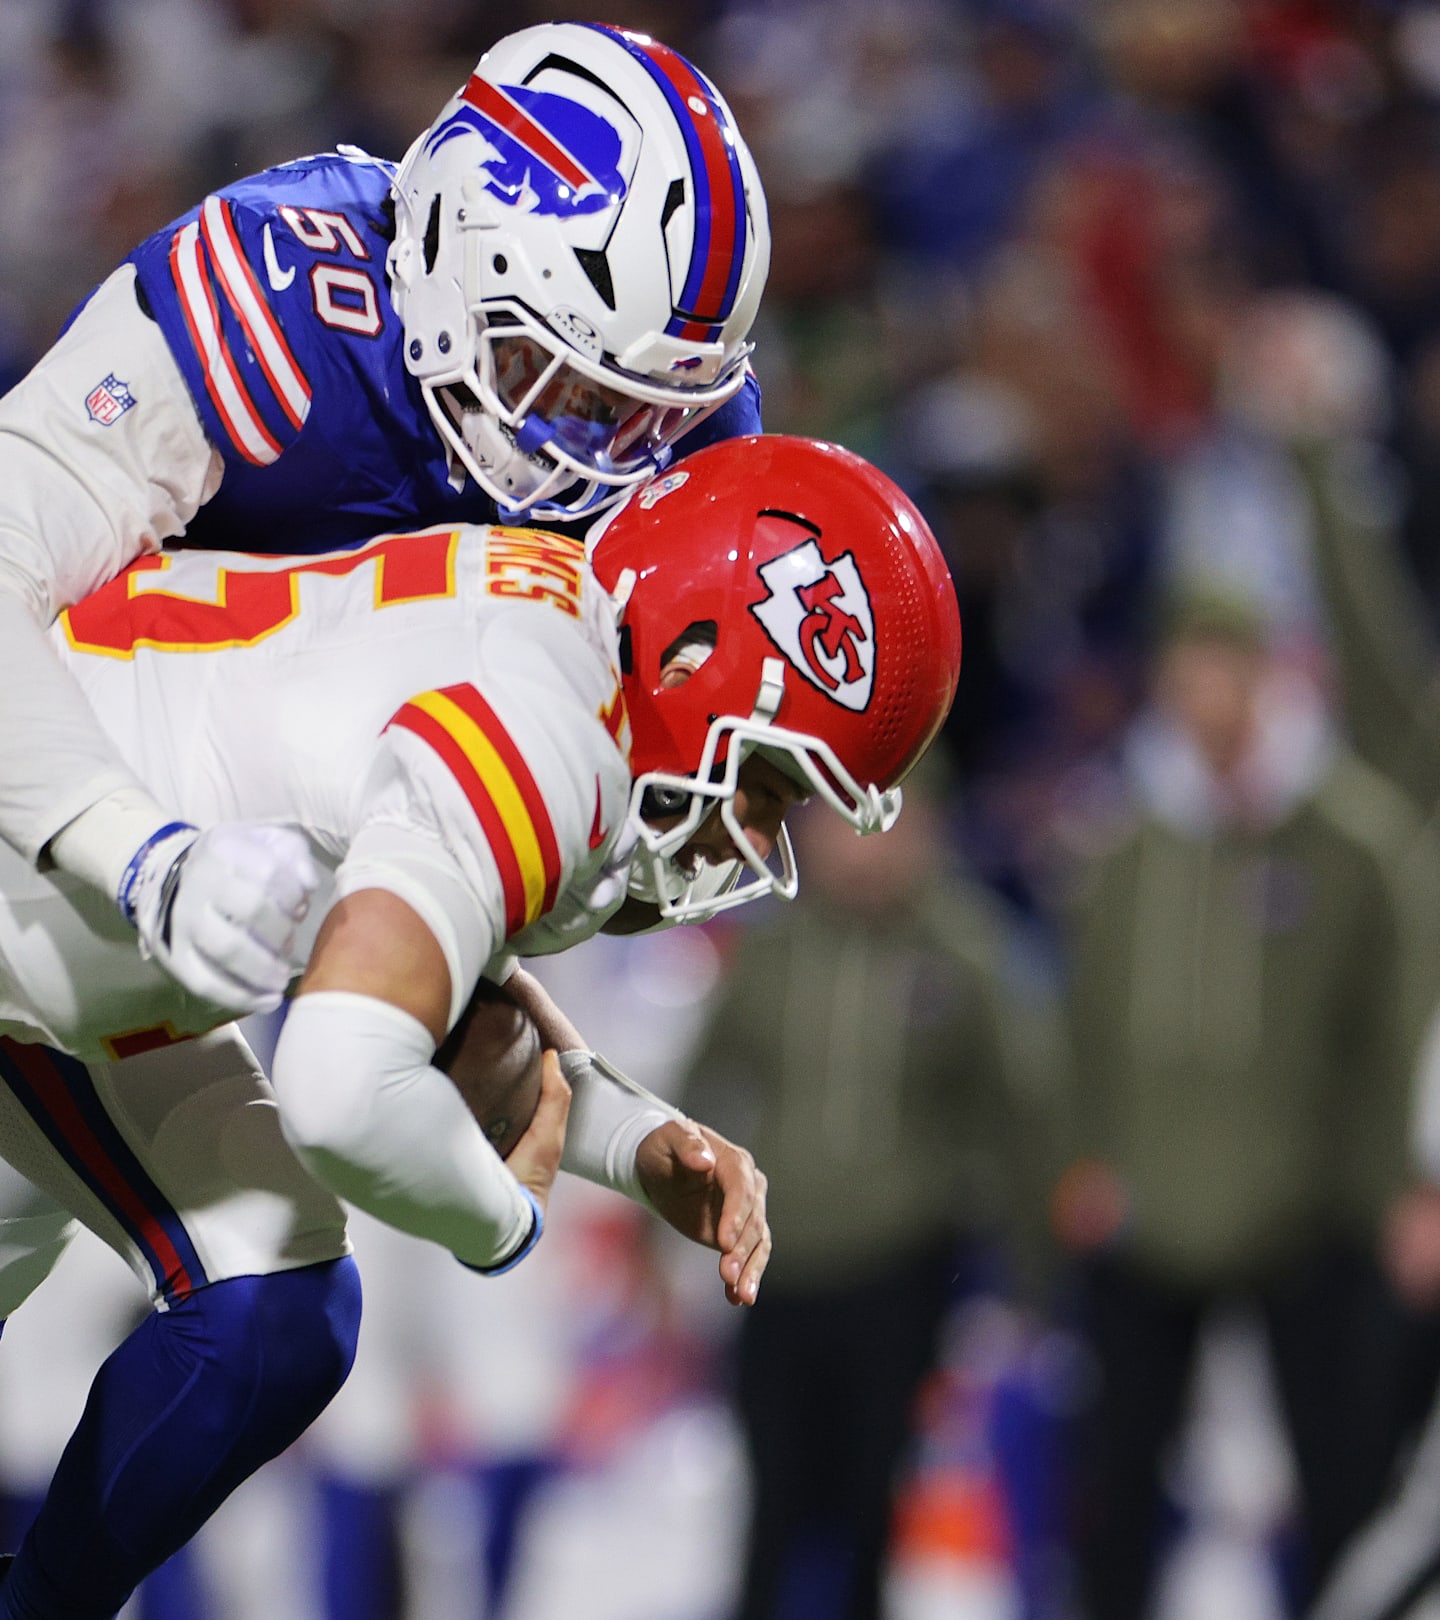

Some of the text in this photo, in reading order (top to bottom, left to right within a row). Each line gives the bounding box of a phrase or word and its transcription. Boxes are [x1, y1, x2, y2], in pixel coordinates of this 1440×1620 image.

[278, 205, 382, 337] 50
[88, 387, 118, 423] NFL
[793, 570, 868, 692] KC
